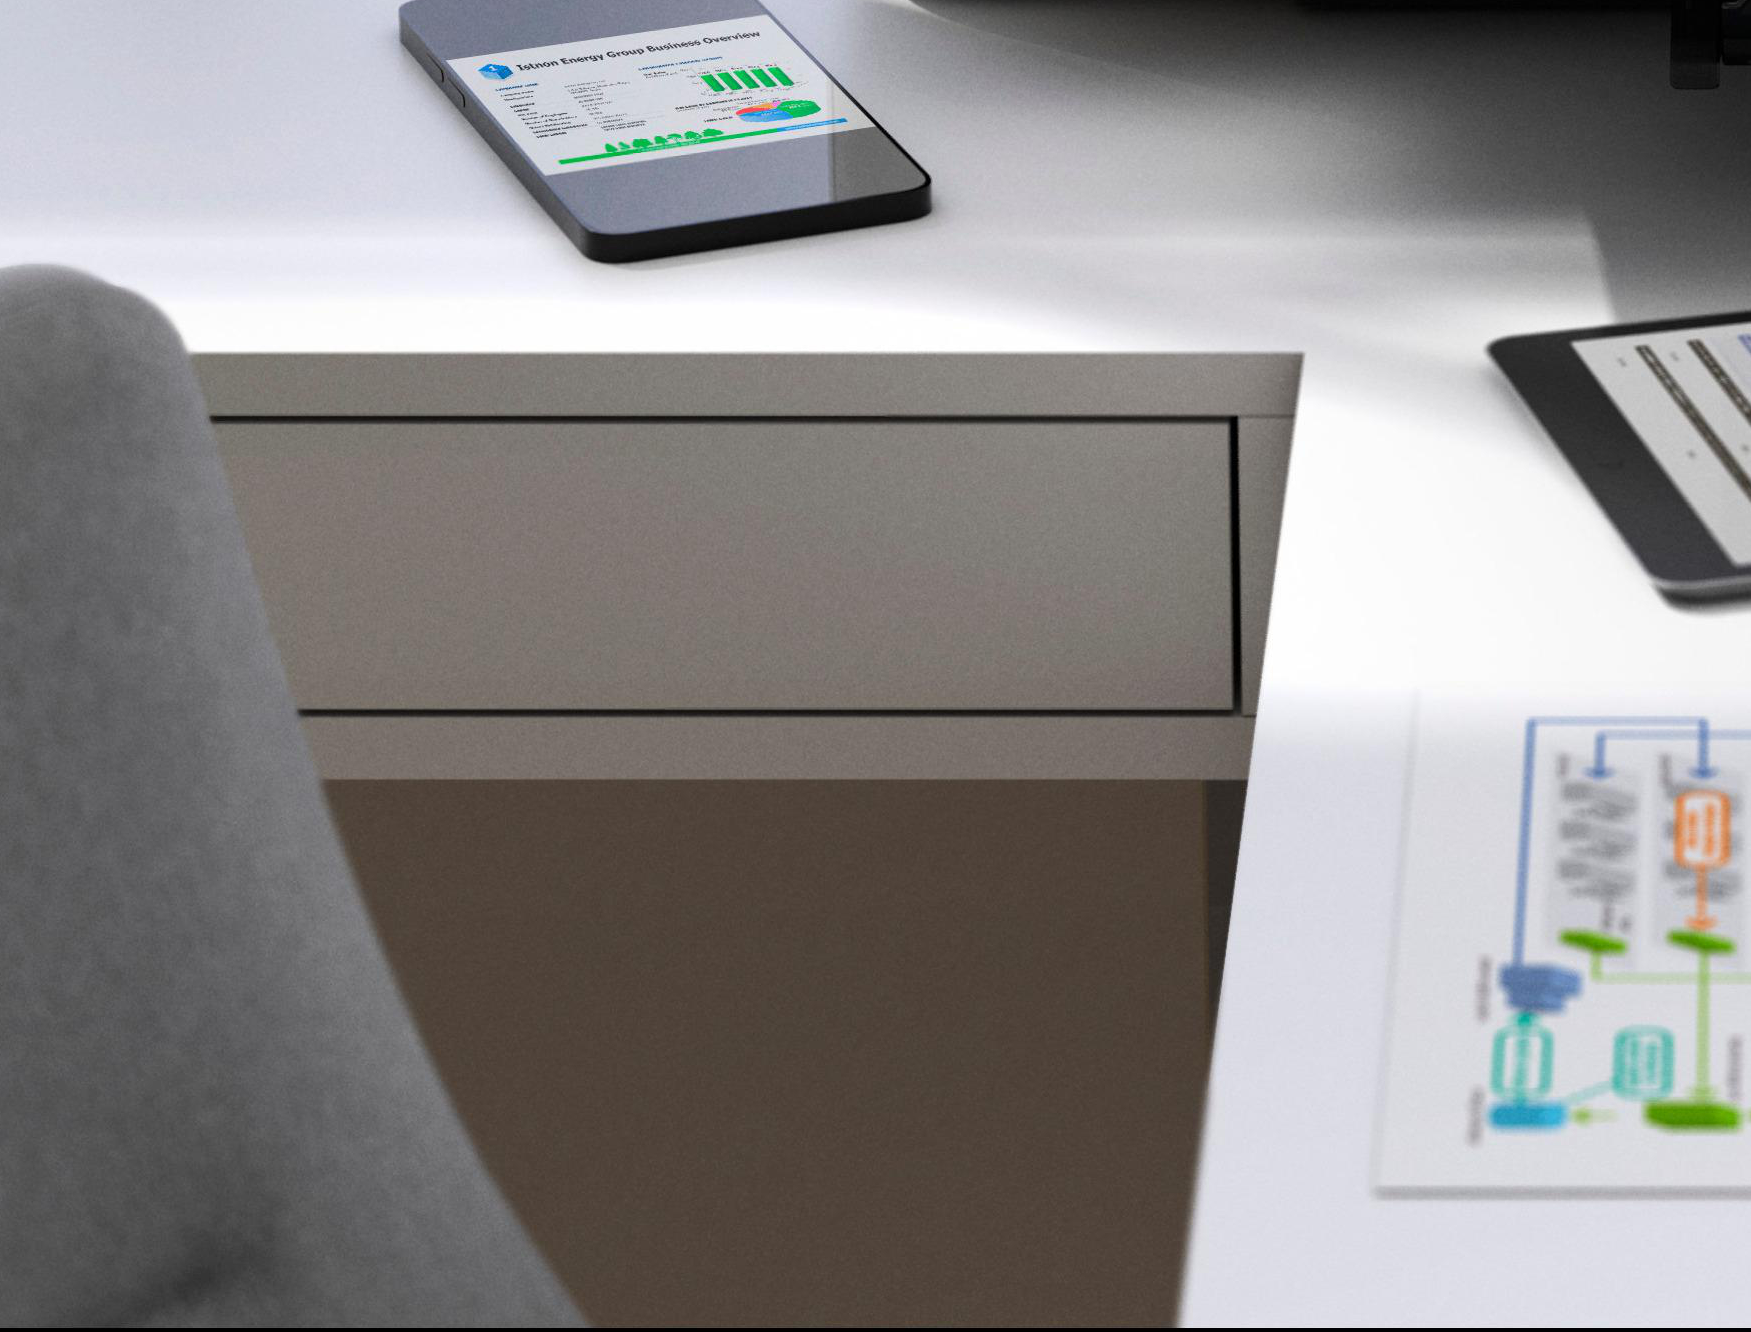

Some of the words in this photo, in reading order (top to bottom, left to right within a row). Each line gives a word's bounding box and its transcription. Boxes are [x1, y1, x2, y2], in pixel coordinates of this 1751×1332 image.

[561, 52, 605, 66] Energy
[606, 46, 645, 60] Group
[645, 39, 701, 53] Business
[703, 30, 761, 45] Overview
